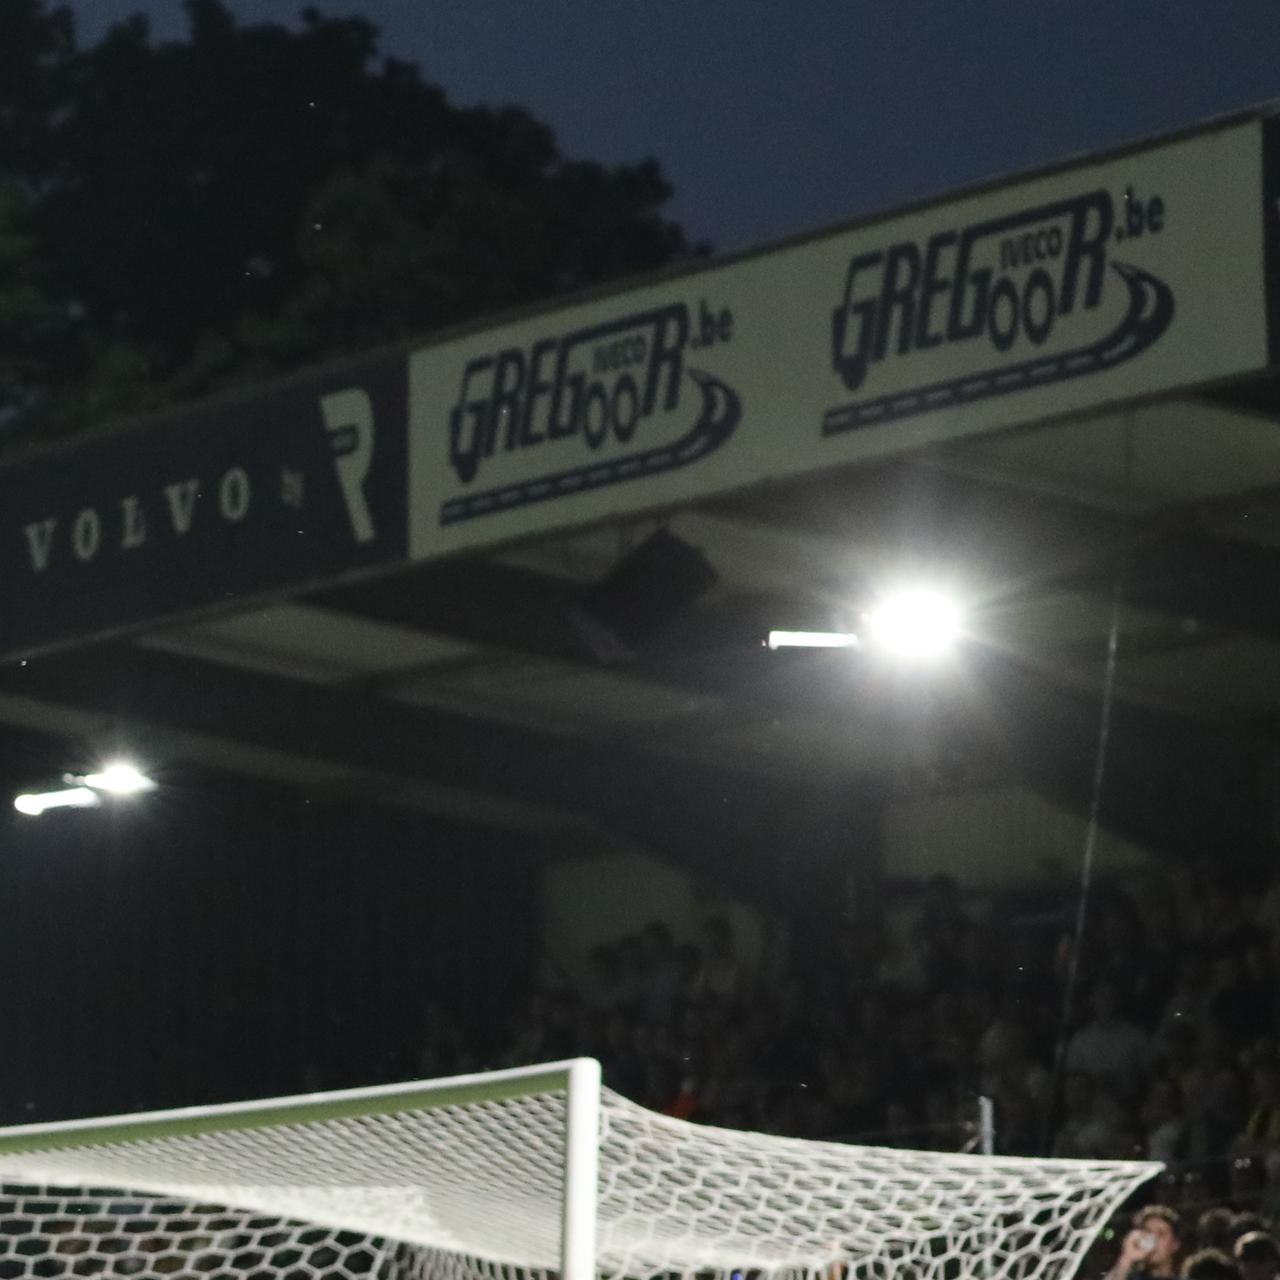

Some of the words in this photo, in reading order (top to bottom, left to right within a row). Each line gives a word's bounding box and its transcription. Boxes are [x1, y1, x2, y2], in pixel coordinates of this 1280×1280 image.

[999, 225, 1064, 271] IVECO
[593, 333, 649, 377] IVECO
[22, 467, 250, 572] VOLVO
